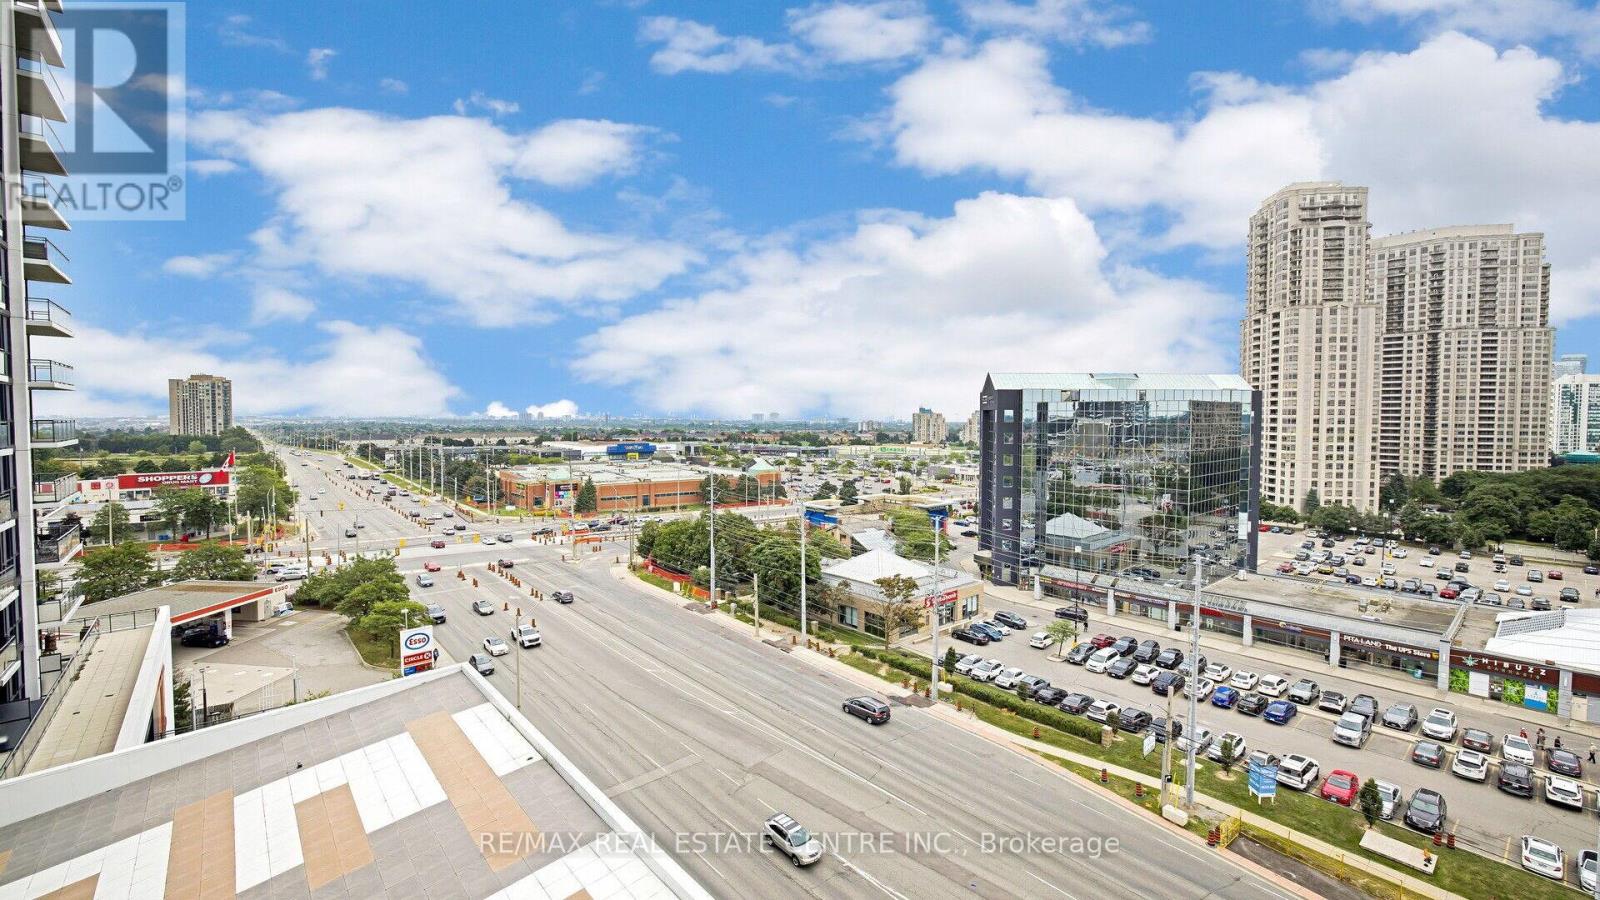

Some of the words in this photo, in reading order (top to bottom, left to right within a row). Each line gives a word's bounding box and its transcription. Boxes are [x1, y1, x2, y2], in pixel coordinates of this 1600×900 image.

[137, 473, 198, 483] SHOPPERS
[1343, 634, 1359, 644] PITA
[1360, 639, 1382, 649] LAND
[1385, 643, 1398, 652] The
[1398, 646, 1412, 654] UPS
[1413, 649, 1431, 658] Store
[404, 655, 424, 663] CIRCLE
